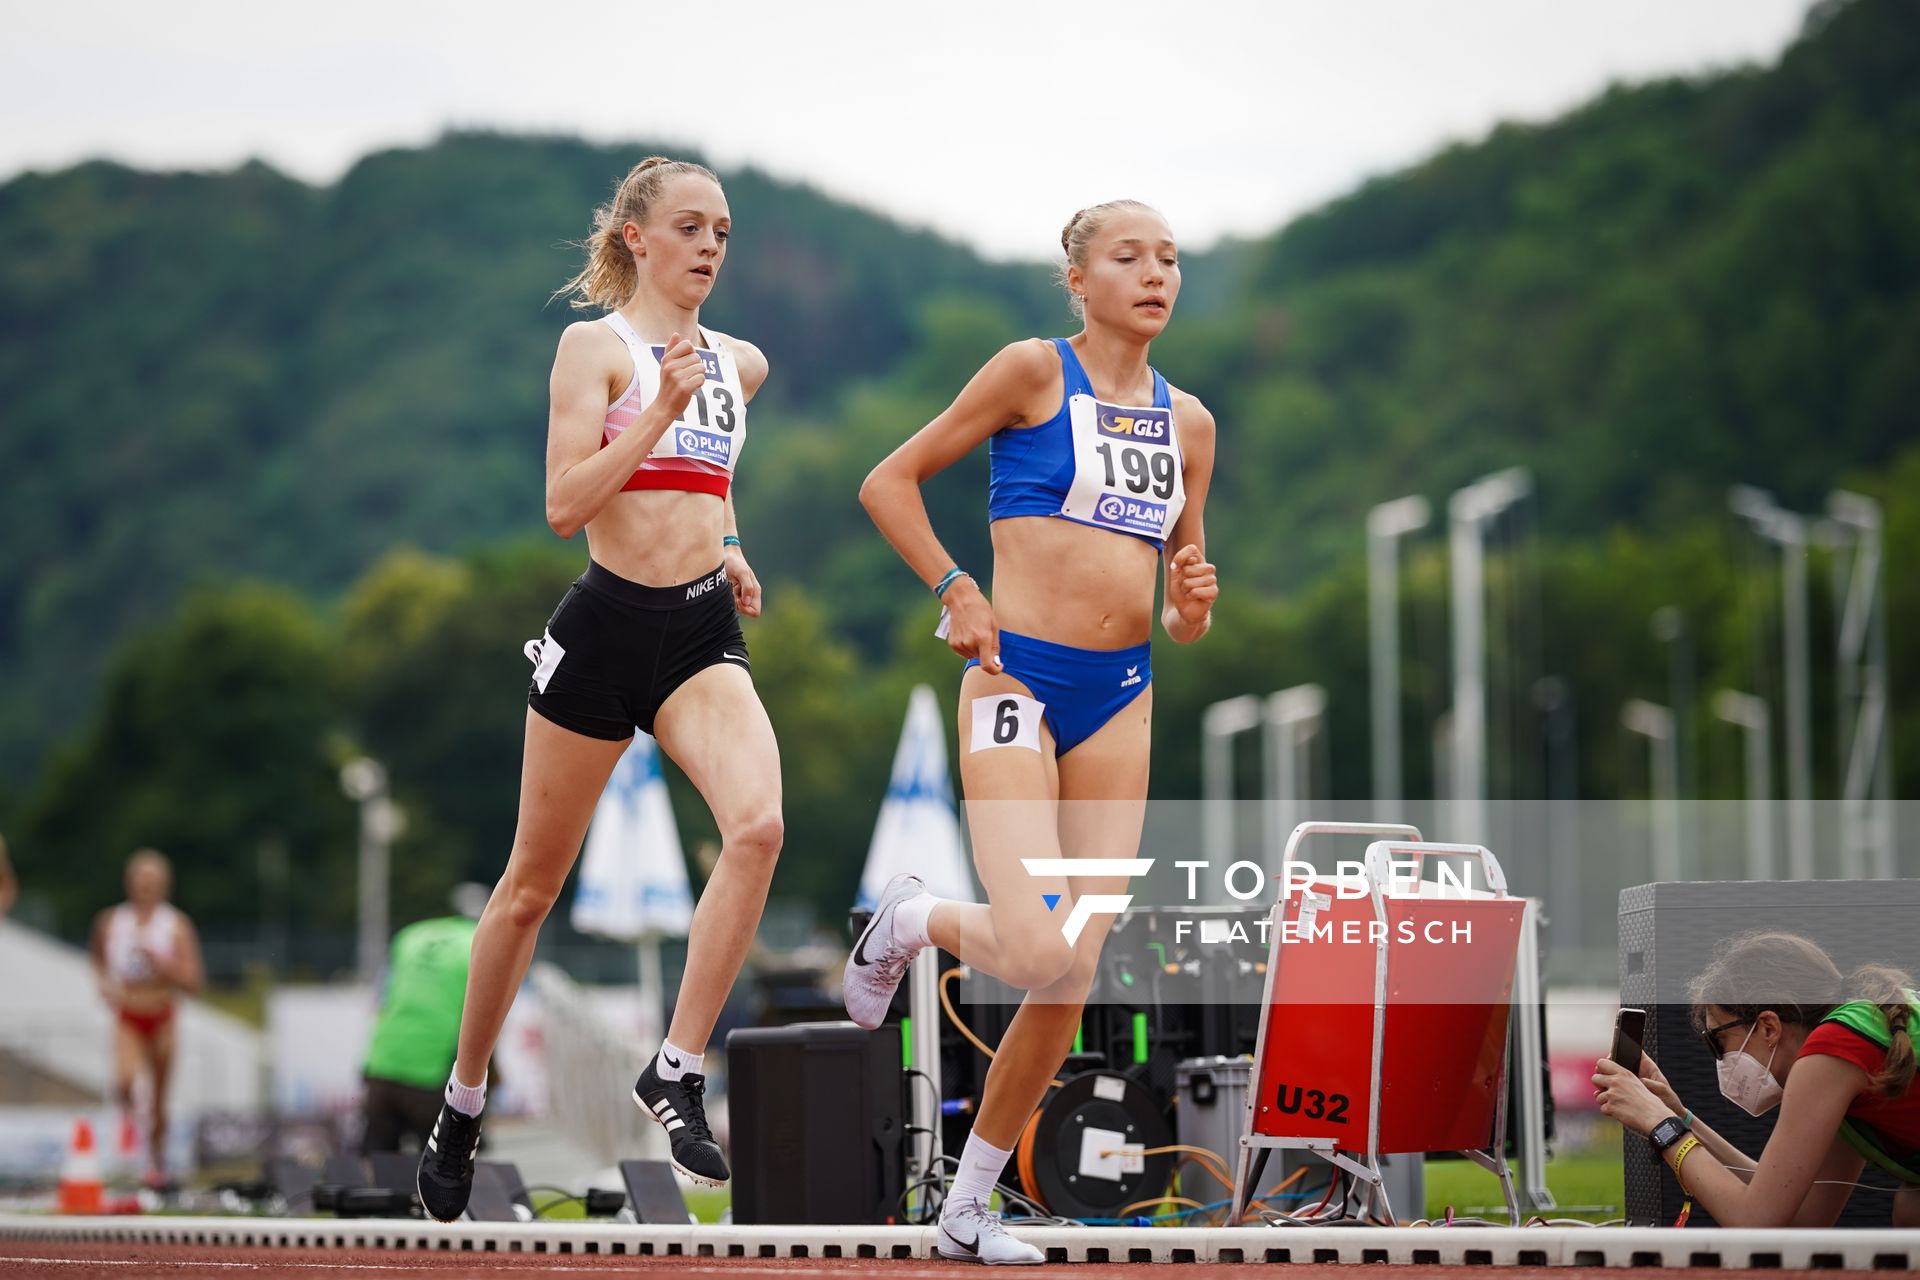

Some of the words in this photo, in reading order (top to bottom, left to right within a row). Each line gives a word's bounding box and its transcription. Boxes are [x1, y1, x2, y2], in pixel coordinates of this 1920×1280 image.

[700, 359, 717, 375] LS
[675, 386, 736, 433] 13
[1134, 418, 1165, 438] GLS
[700, 436, 729, 455] PLAN
[1096, 442, 1175, 500] 199
[1126, 502, 1165, 523] PLAN
[686, 576, 715, 600] NIKE
[993, 699, 1019, 745] 6
[1276, 1083, 1350, 1125] U32
